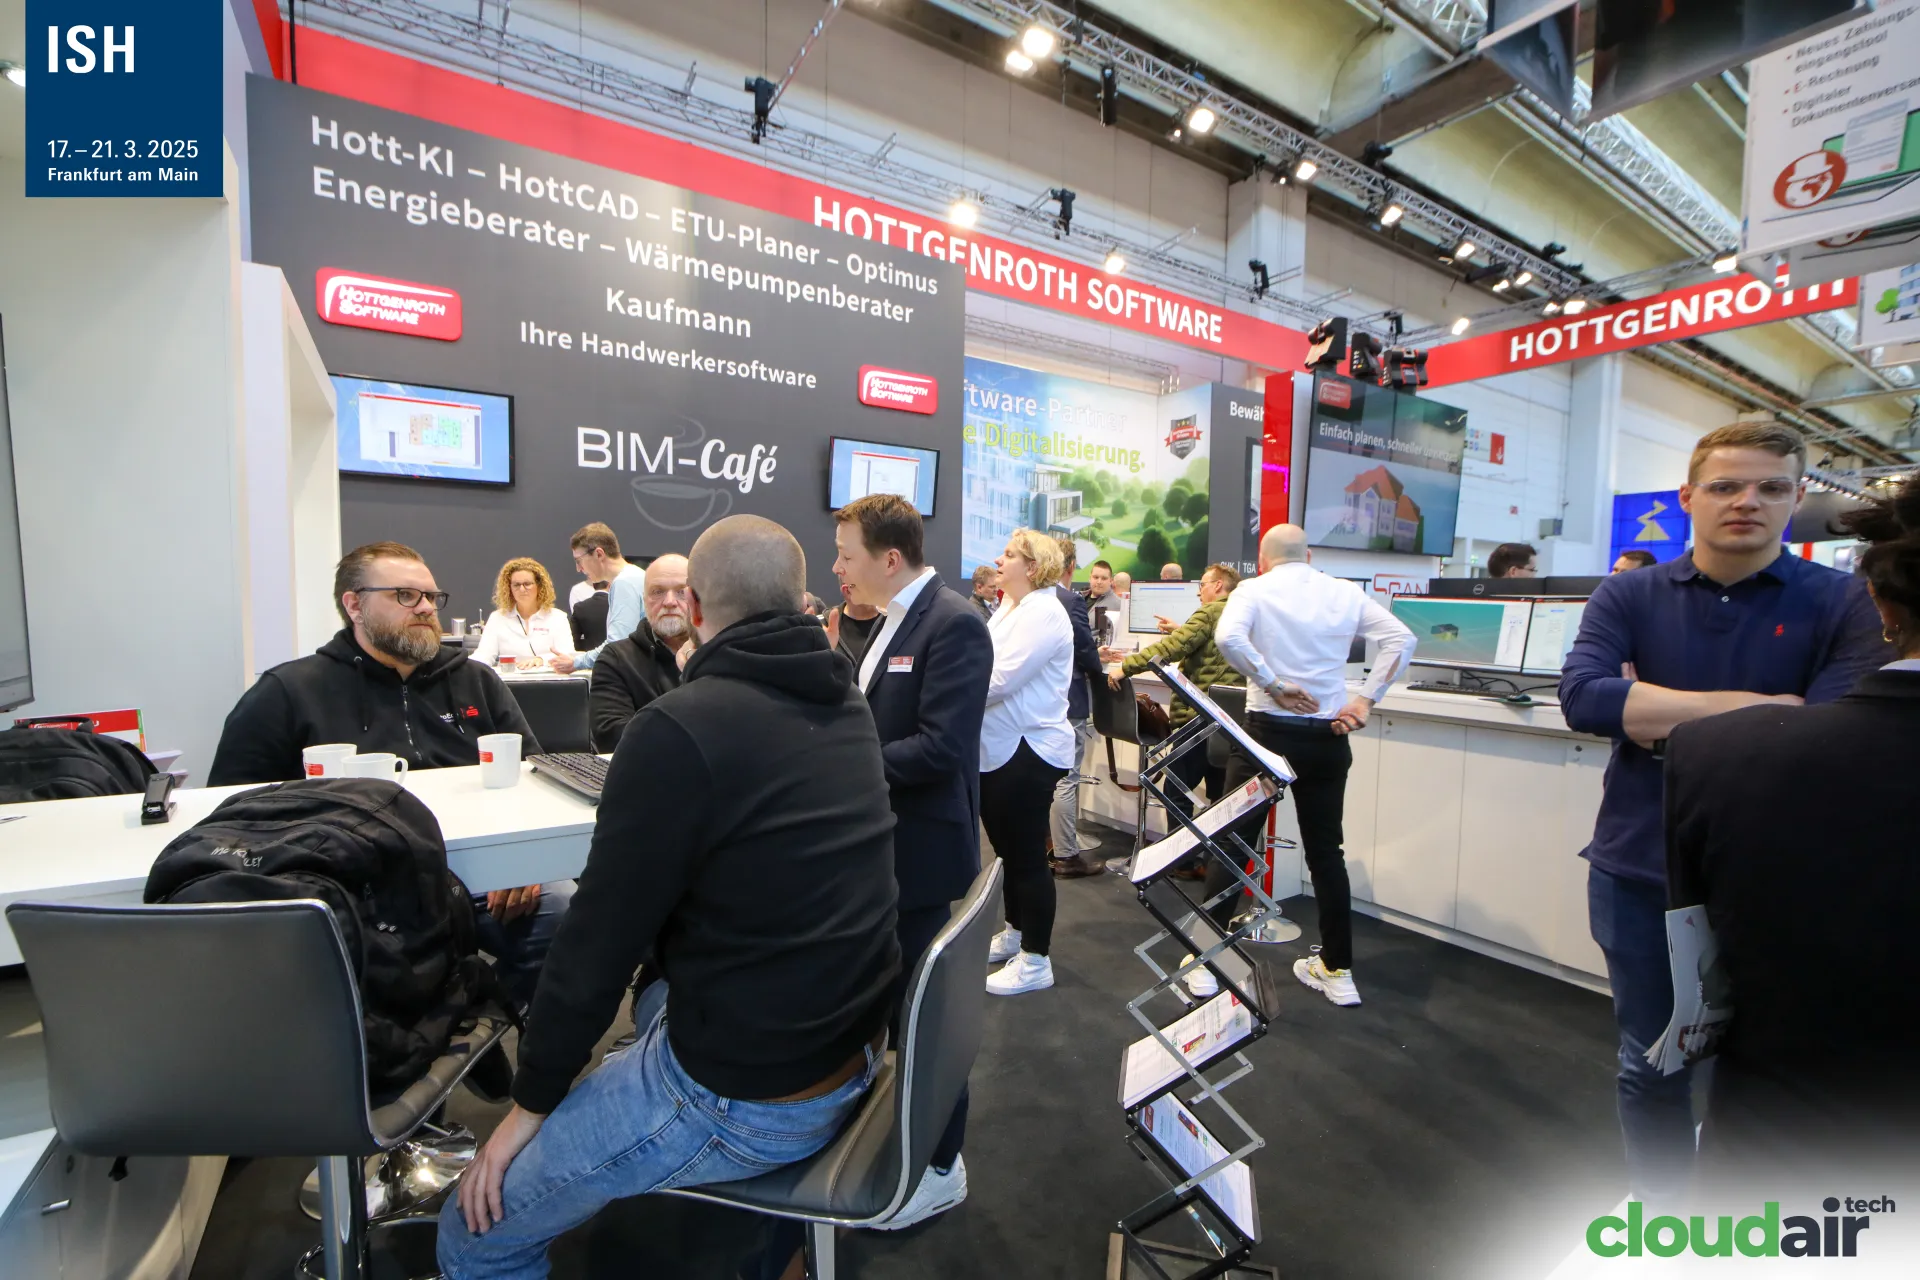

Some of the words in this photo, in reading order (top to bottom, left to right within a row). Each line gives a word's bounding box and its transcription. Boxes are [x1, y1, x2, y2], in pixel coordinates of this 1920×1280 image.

[312, 116, 453, 178] Hott-KI
[499, 162, 639, 221] HottCAD
[671, 208, 821, 266] ETU-Planer
[846, 253, 939, 295] Optimus
[313, 166, 591, 253] Energieberater
[626, 236, 914, 323] Wärmepumpenberater
[814, 195, 1077, 304] HOTTGENROTH
[1086, 278, 1223, 344] SOFTWARE
[338, 298, 420, 325] SOFTWARE
[606, 286, 751, 338] Kaufmann
[520, 320, 573, 350] Ihre
[582, 331, 817, 389] Handwerkersoftware
[577, 426, 778, 494] BIM-Café
[985, 422, 1146, 474] Digitalisierung.
[1319, 421, 1353, 442] Einfach
[1354, 430, 1386, 449] planen,
